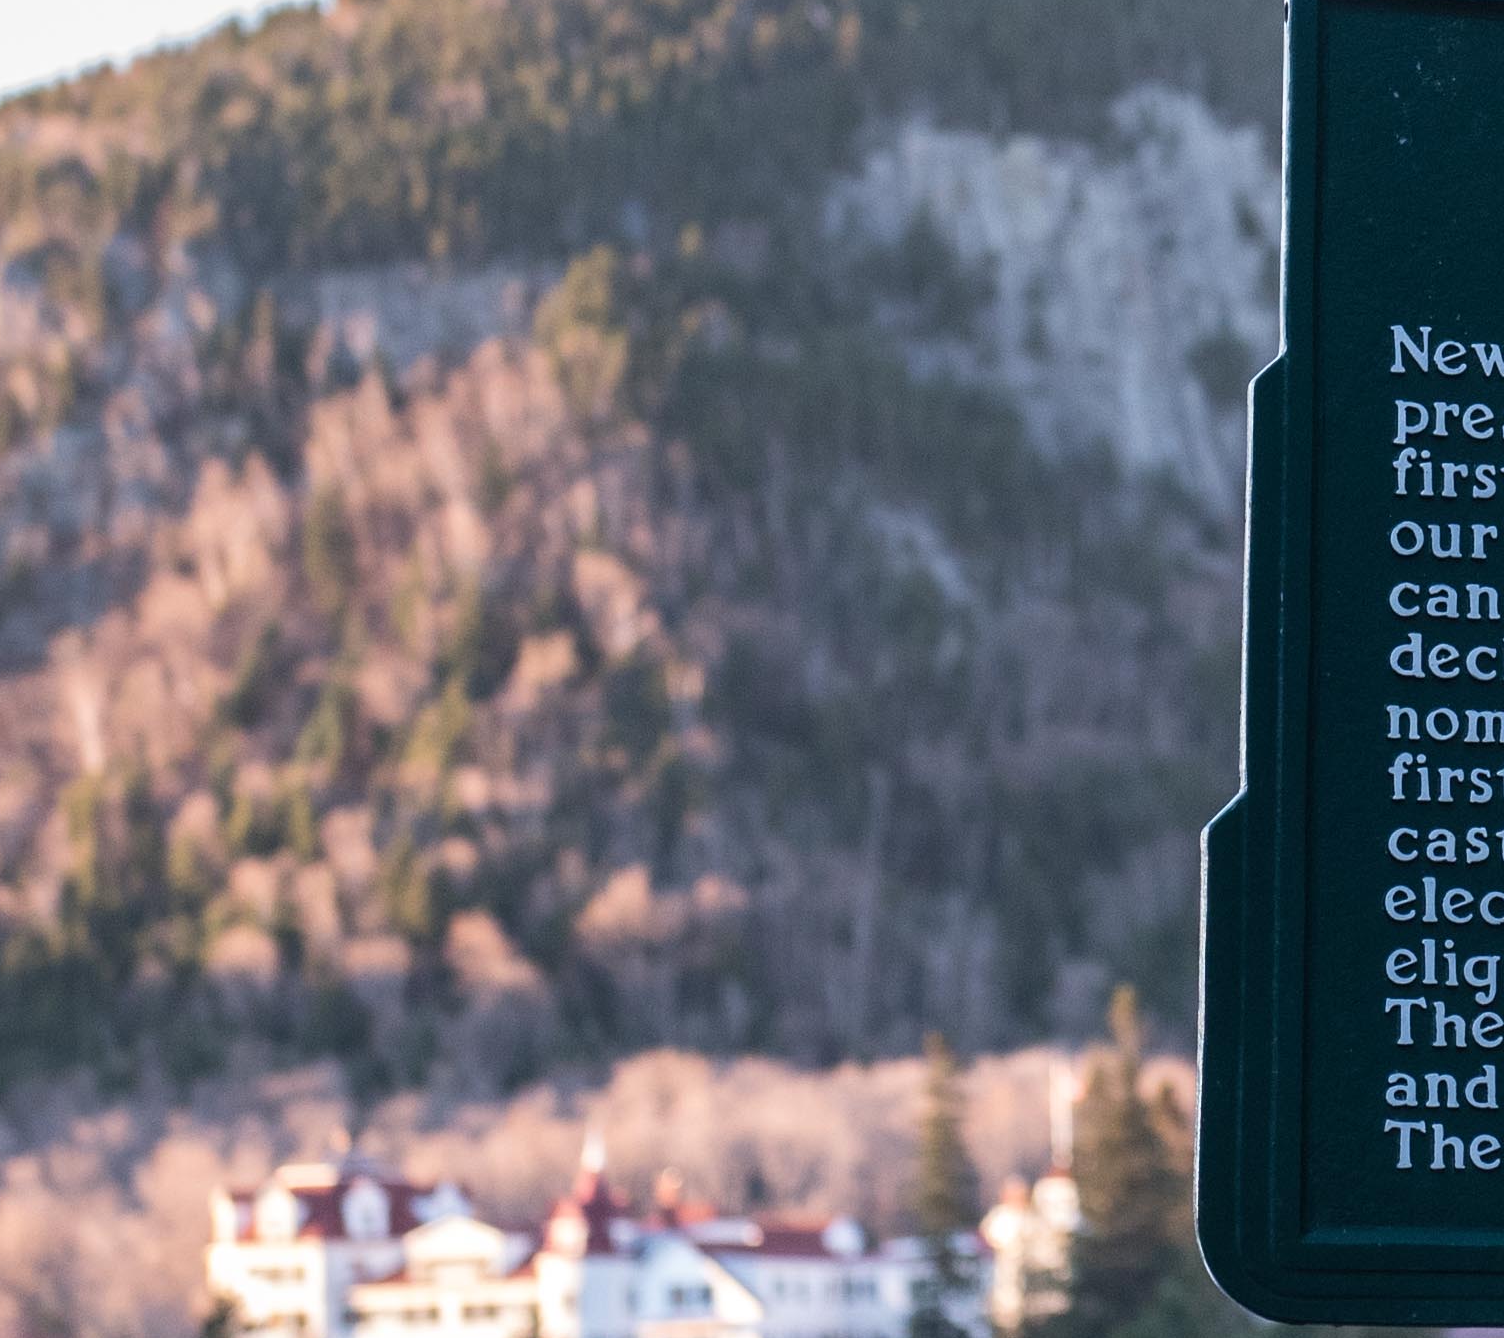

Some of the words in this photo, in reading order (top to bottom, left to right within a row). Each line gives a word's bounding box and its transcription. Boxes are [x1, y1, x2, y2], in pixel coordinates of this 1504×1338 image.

[1388, 519, 1500, 560] our
[1384, 1062, 1500, 1110] and
[1382, 1117, 1503, 1171] The
